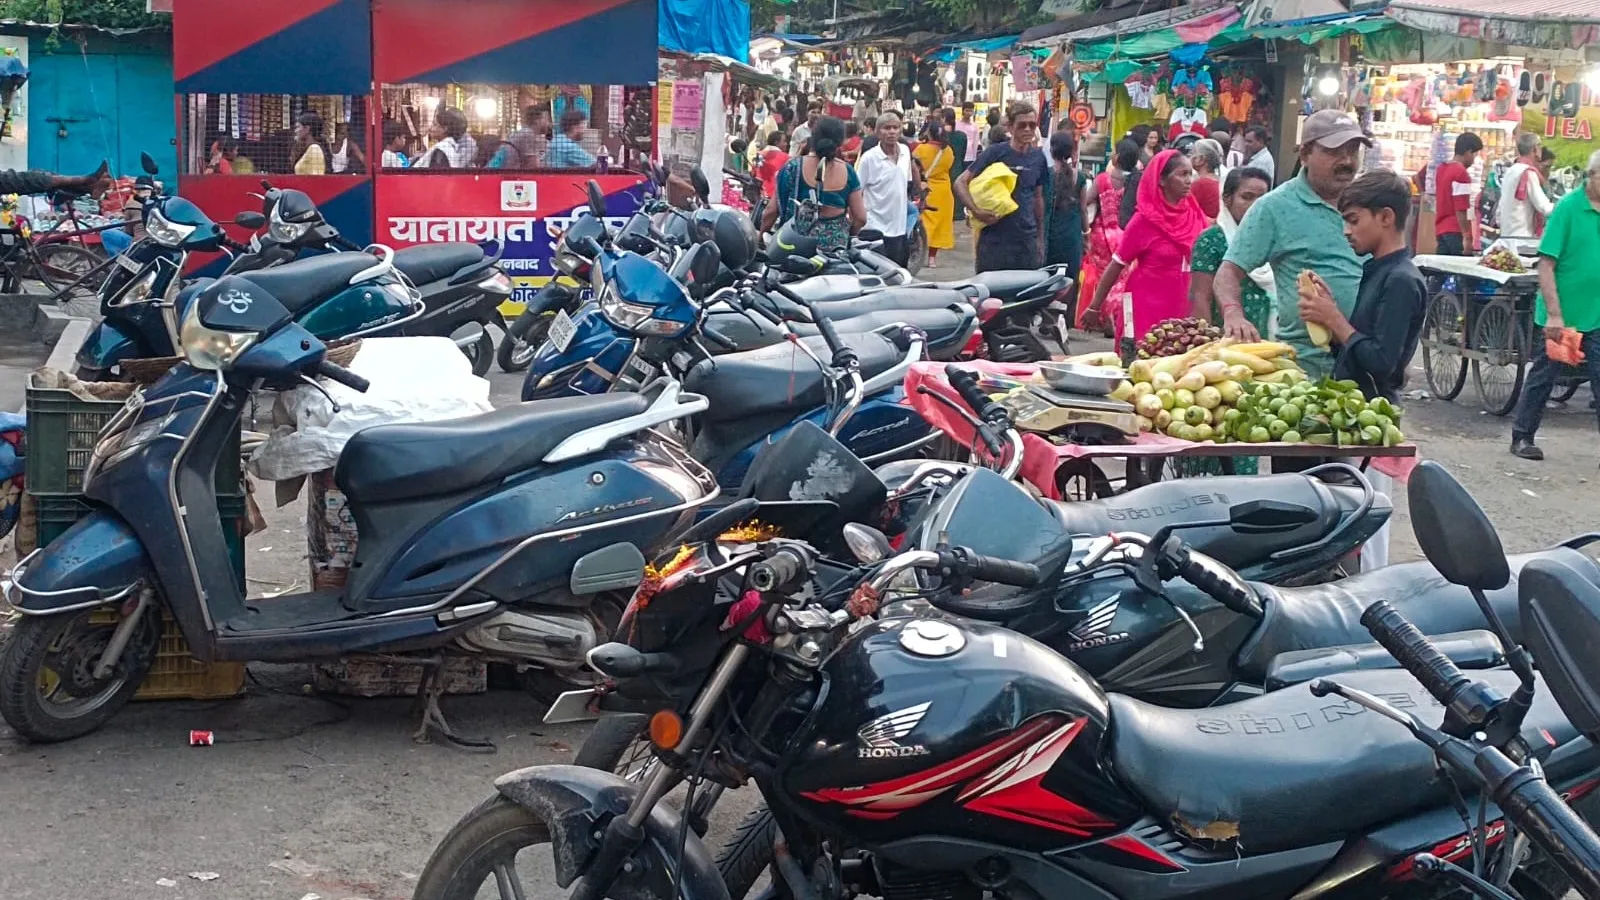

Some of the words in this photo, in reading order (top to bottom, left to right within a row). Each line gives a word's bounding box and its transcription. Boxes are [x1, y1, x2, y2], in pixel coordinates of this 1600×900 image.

[388, 216, 536, 242] यातायात
[499, 258, 540, 270] नबाद
[1070, 632, 1132, 652] HONDA
[858, 745, 931, 758] HONDA
